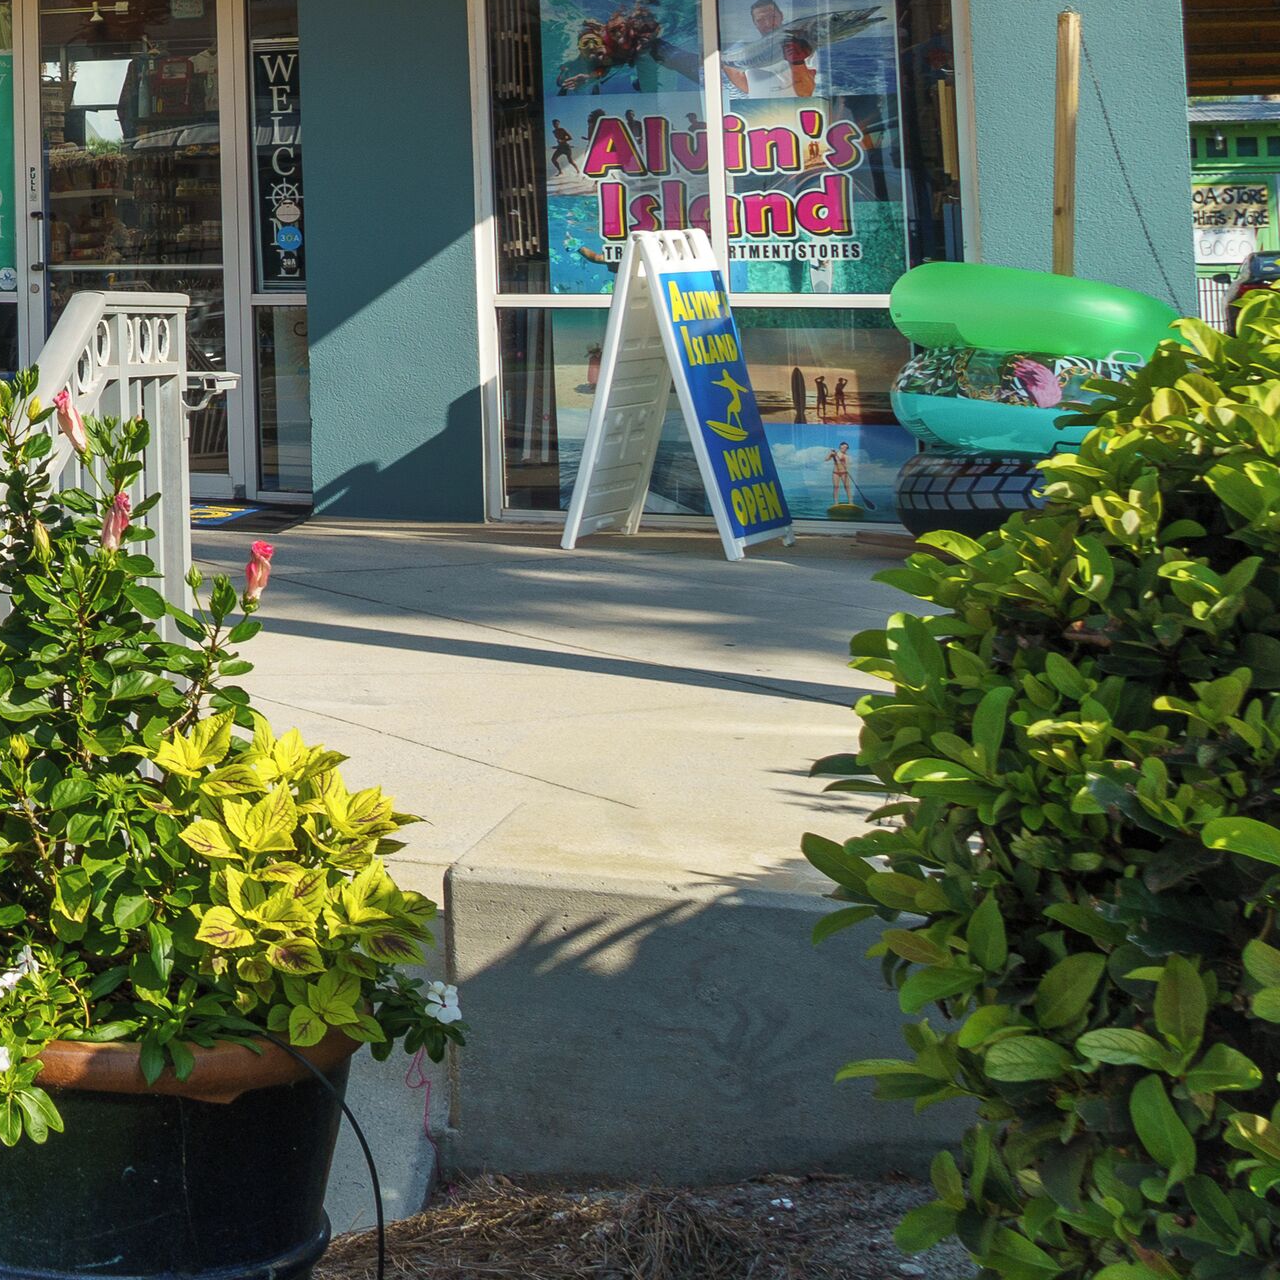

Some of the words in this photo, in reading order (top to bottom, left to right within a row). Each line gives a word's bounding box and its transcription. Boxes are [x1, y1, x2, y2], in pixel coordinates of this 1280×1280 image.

[583, 109, 863, 176] Alvin's
[600, 172, 855, 240] Island
[1192, 186, 1220, 206] OA
[1221, 185, 1268, 205] STORE
[728, 244, 791, 260] RTMENT
[798, 243, 861, 260] STORES
[680, 325, 738, 367] ISLAND
[723, 445, 764, 482] NOW
[730, 481, 784, 527] OPEN
